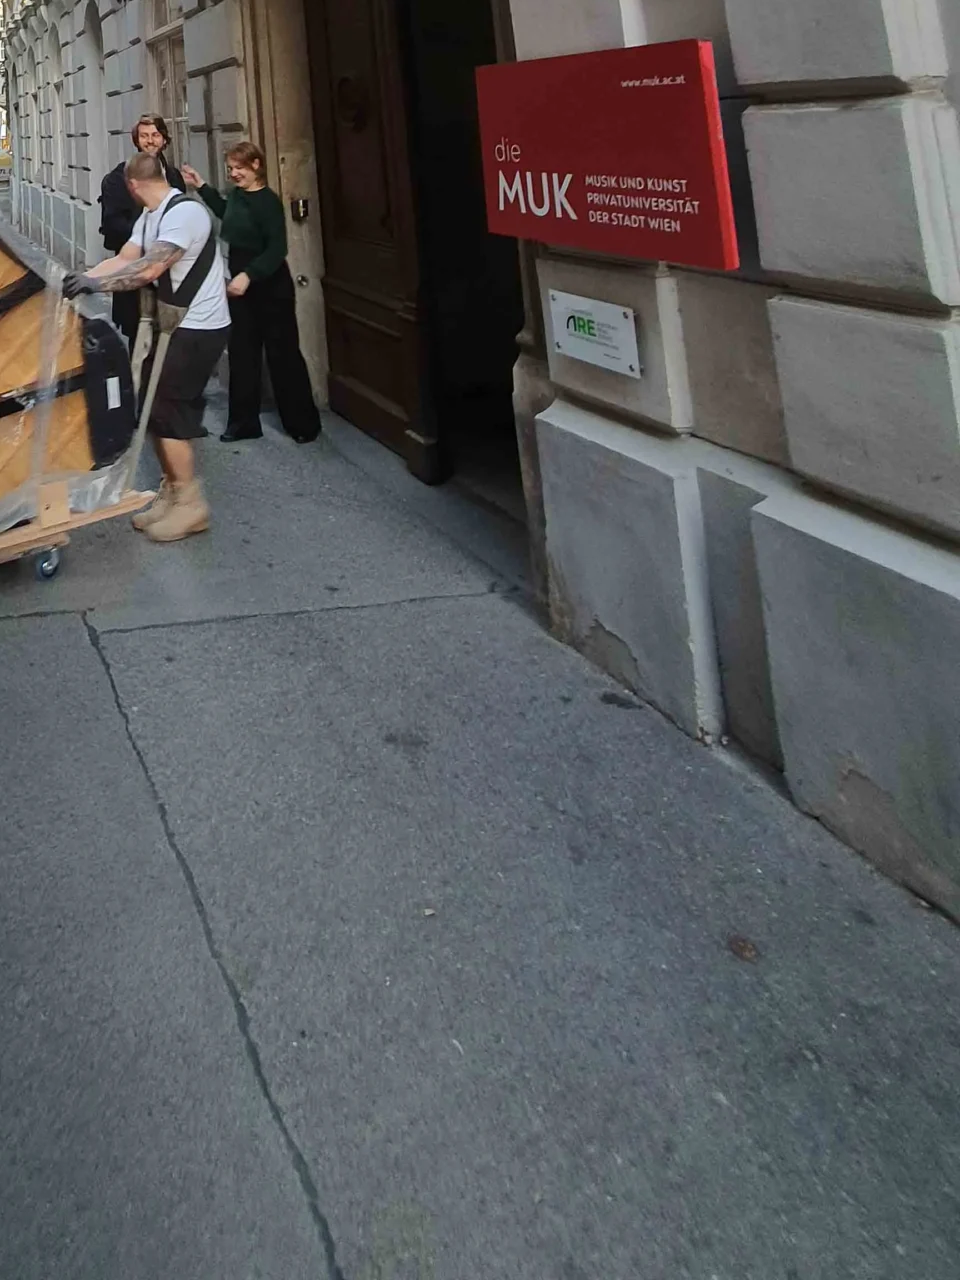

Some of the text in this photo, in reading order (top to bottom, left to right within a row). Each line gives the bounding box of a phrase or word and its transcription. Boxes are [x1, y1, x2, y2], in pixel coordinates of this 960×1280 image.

[620, 74, 686, 88] www.muk.ac.at
[494, 137, 521, 163] die
[498, 170, 578, 220] MUK
[585, 175, 688, 193] MUSIK UND KUNST
[587, 192, 699, 215] PRIVATUNIVERSITÄT
[588, 210, 681, 232] DER STADT WIEN
